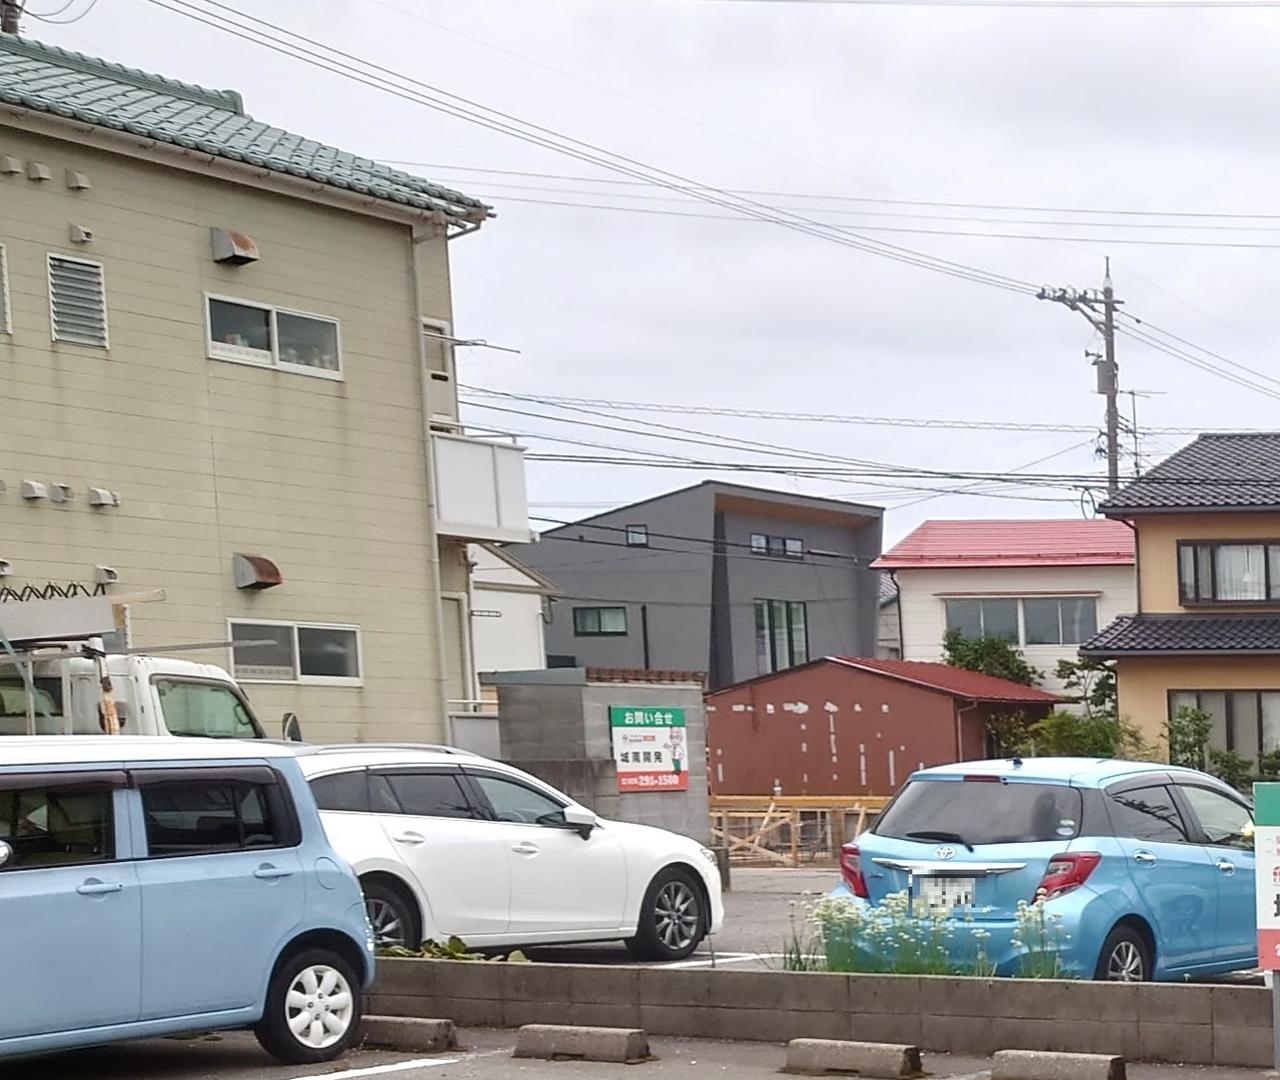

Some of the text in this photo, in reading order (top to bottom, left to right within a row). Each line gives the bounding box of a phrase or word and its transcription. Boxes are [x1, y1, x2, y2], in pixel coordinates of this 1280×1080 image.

[624, 711, 673, 725] お問い合せ
